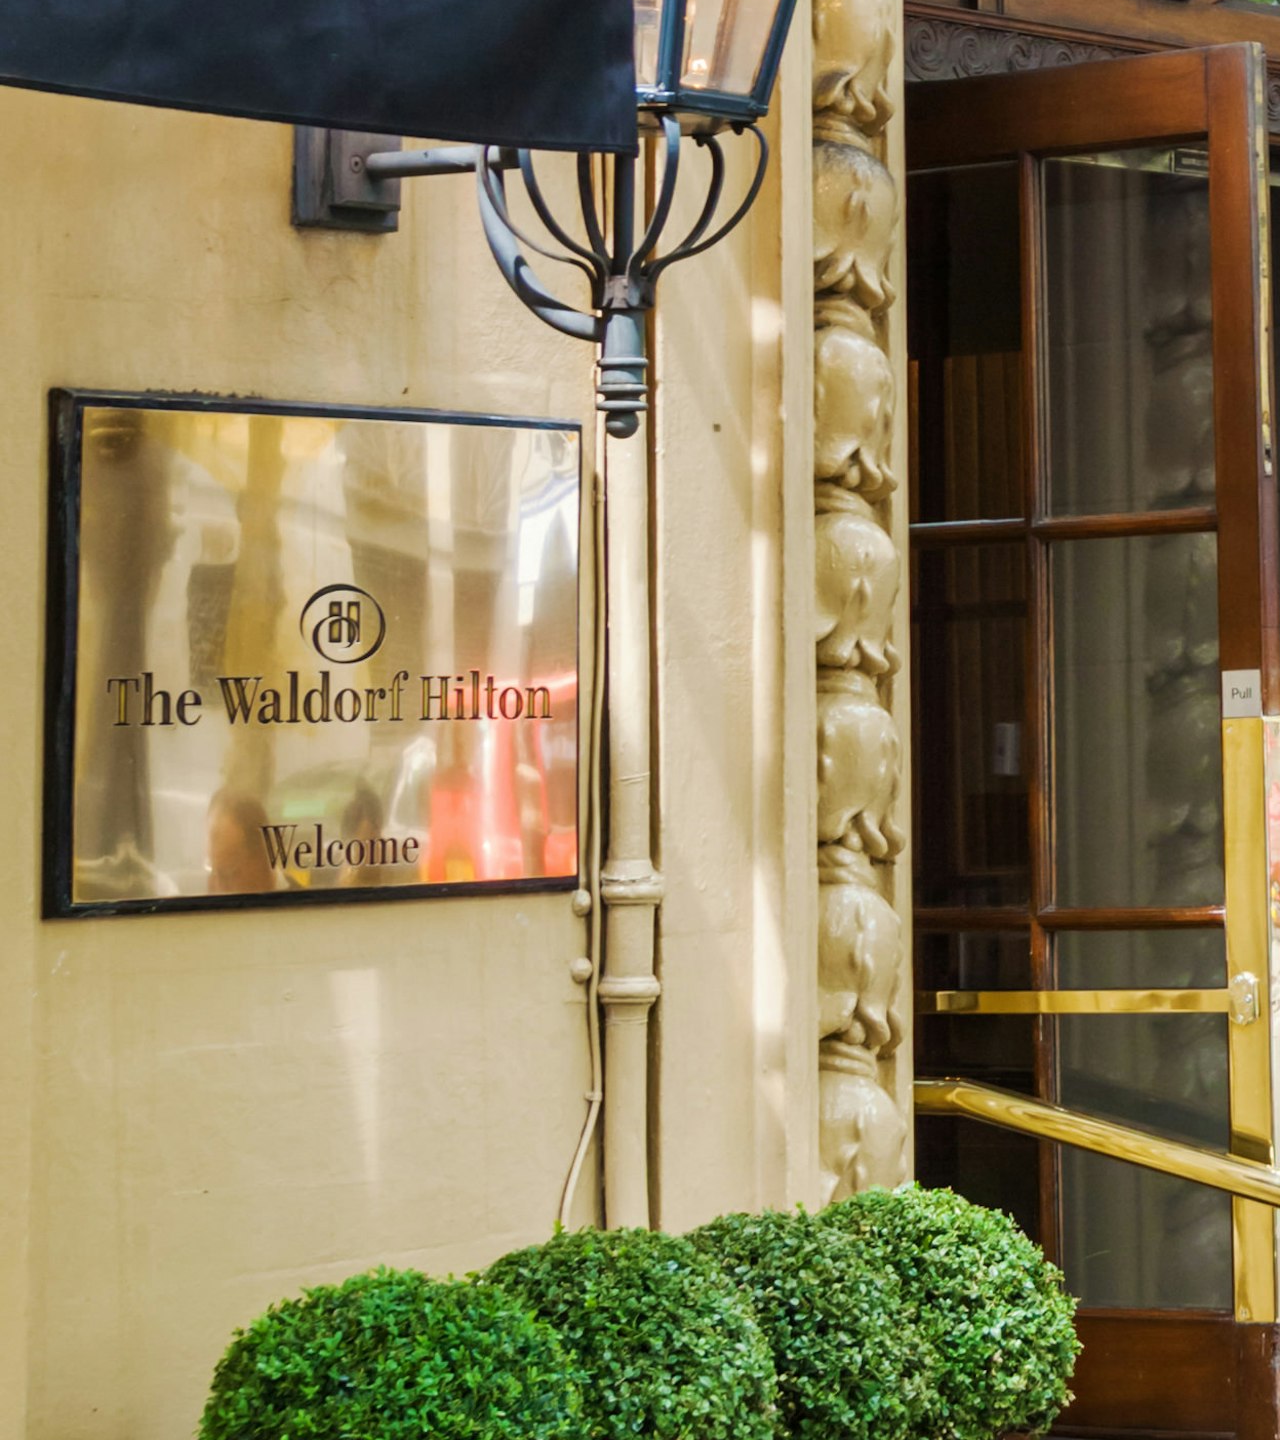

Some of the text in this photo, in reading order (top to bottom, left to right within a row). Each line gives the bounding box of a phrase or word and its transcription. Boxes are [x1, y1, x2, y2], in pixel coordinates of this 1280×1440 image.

[107, 669, 554, 727] The Waldorf Hilton
[1231, 687, 1252, 700] Pull
[260, 821, 420, 871] Welcome
